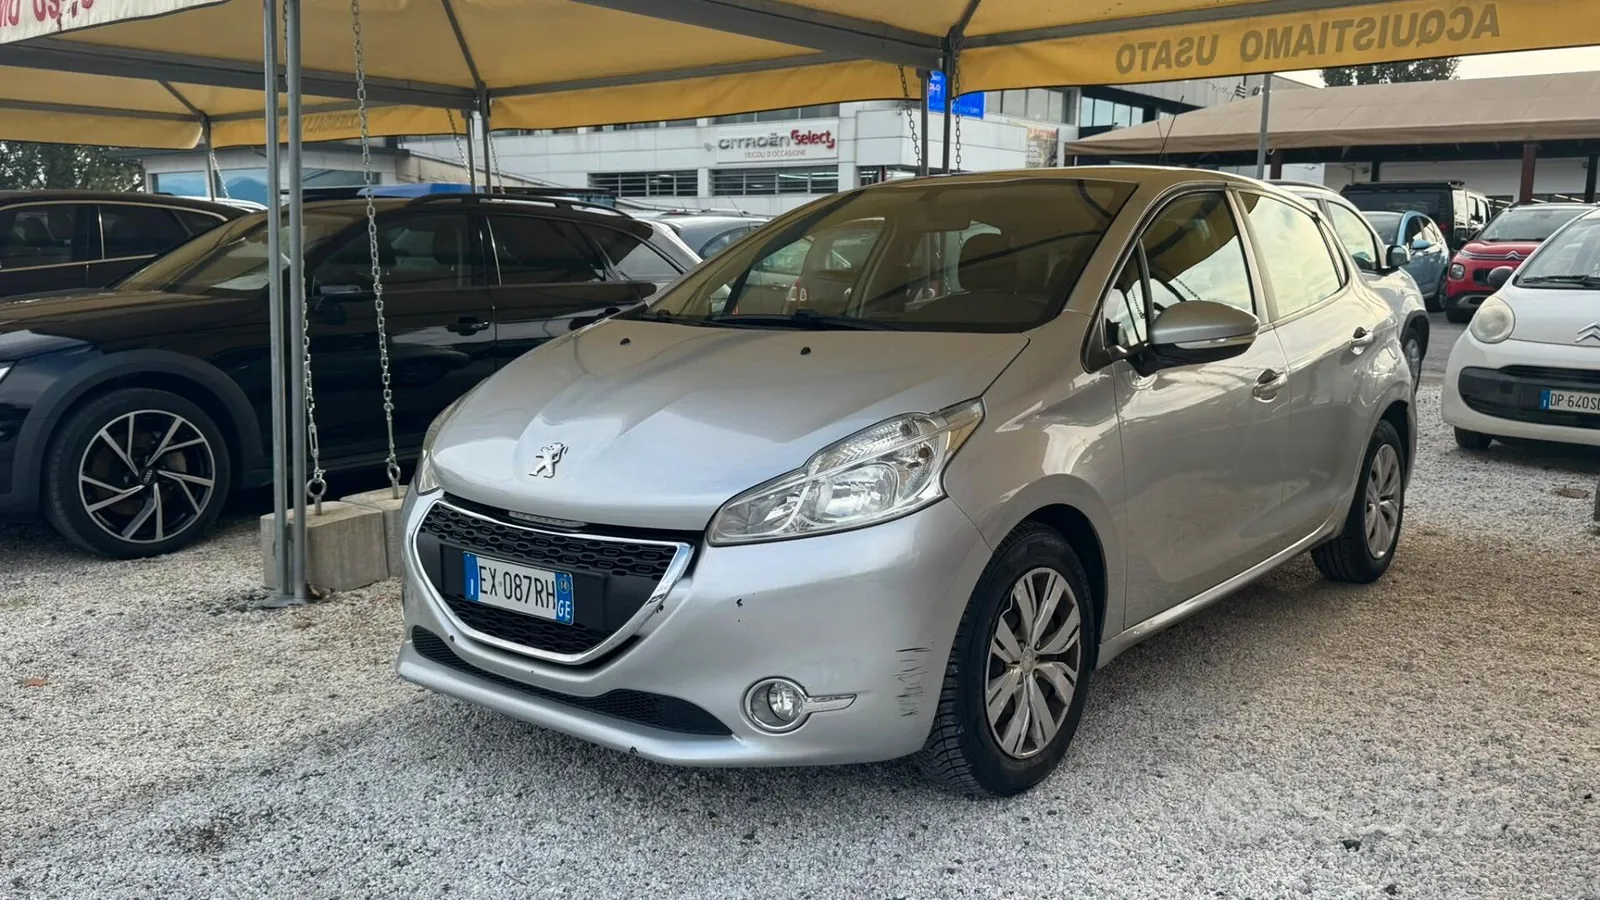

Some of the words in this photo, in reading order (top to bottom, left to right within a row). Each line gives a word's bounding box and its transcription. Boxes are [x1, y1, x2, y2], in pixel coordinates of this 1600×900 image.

[1550, 393, 1565, 407] DP
[479, 565, 498, 597] EX
[502, 571, 556, 610] 087RH
[557, 599, 571, 619] GE
